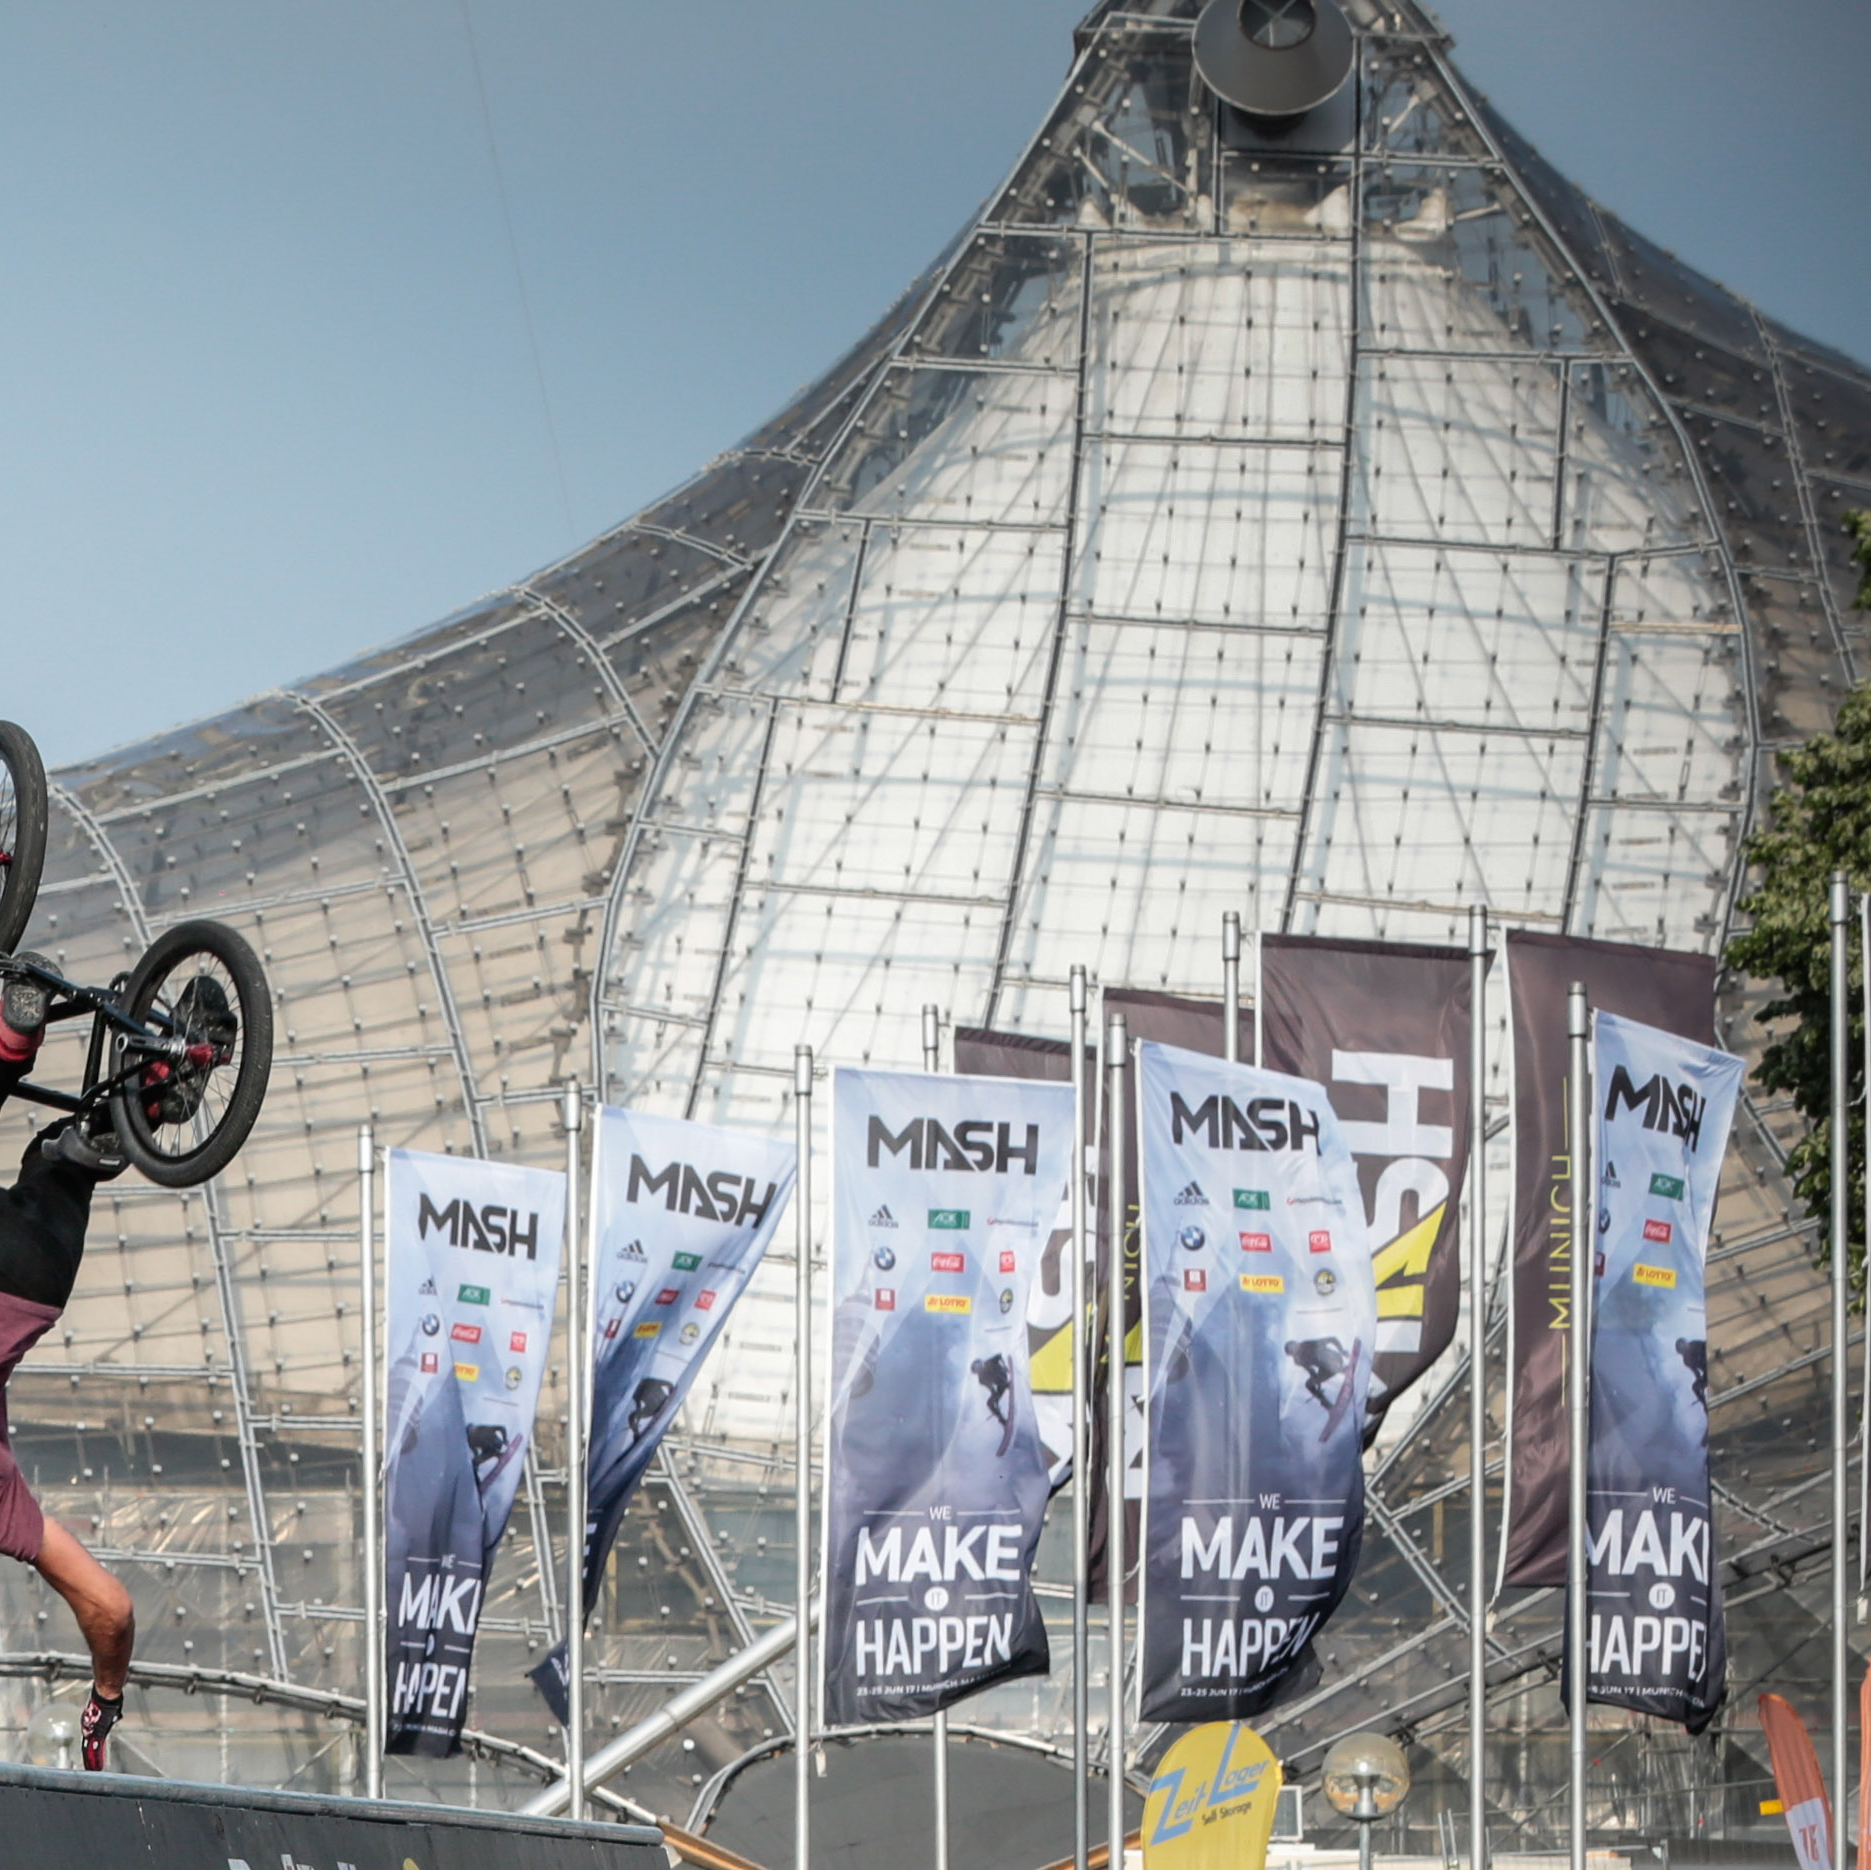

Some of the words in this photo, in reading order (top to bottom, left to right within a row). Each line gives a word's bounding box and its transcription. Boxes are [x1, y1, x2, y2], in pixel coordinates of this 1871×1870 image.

[1169, 1091, 1323, 1156] MASH
[1606, 1065, 1706, 1153] MASH
[867, 1115, 1039, 1175] MASH
[626, 1153, 777, 1230] MASH
[419, 1193, 539, 1260] MASH
[1331, 1049, 1454, 1400] ASH
[939, 1298, 967, 1308] LOTTO
[1252, 1278, 1279, 1287] LOTTO
[929, 1505, 951, 1520] WE
[1259, 1494, 1280, 1510] WE
[1653, 1487, 1675, 1504] WE
[856, 1523, 1021, 1586] MAKE
[1181, 1515, 1345, 1581] MAKE
[857, 1612, 1012, 1677] HAPPEN
[1586, 1614, 1706, 1682] APPE
[884, 1683, 904, 1695] JUN
[1208, 1688, 1228, 1697] JUN
[1202, 1810, 1218, 1826] Self
[1219, 1800, 1253, 1819] Storage
